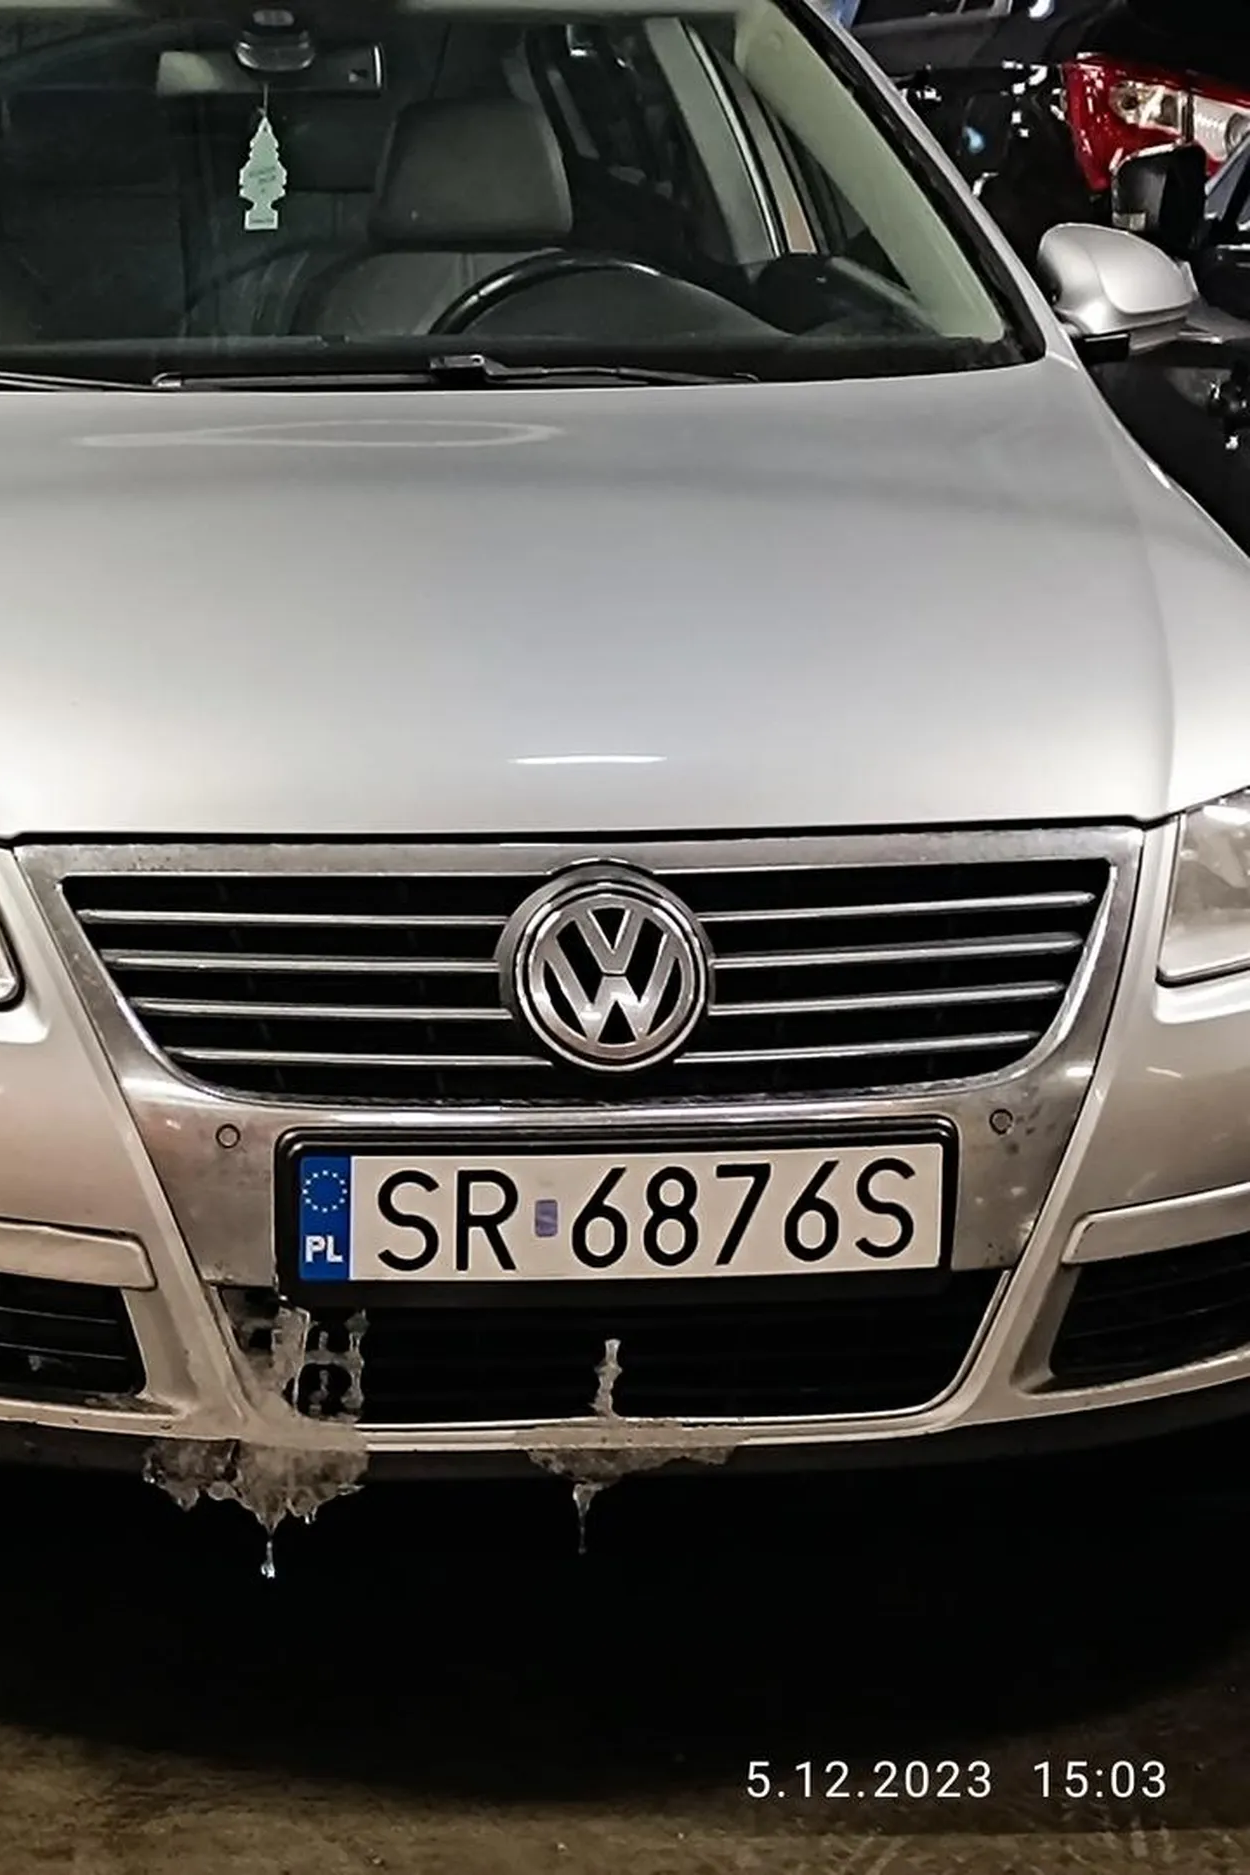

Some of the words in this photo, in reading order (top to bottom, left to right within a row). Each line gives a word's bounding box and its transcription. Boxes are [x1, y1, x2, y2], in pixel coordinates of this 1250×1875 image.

[535, 896, 692, 1053] VW
[305, 1236, 343, 1264] PL
[377, 1168, 519, 1272] SR
[570, 1157, 917, 1269] 6876S
